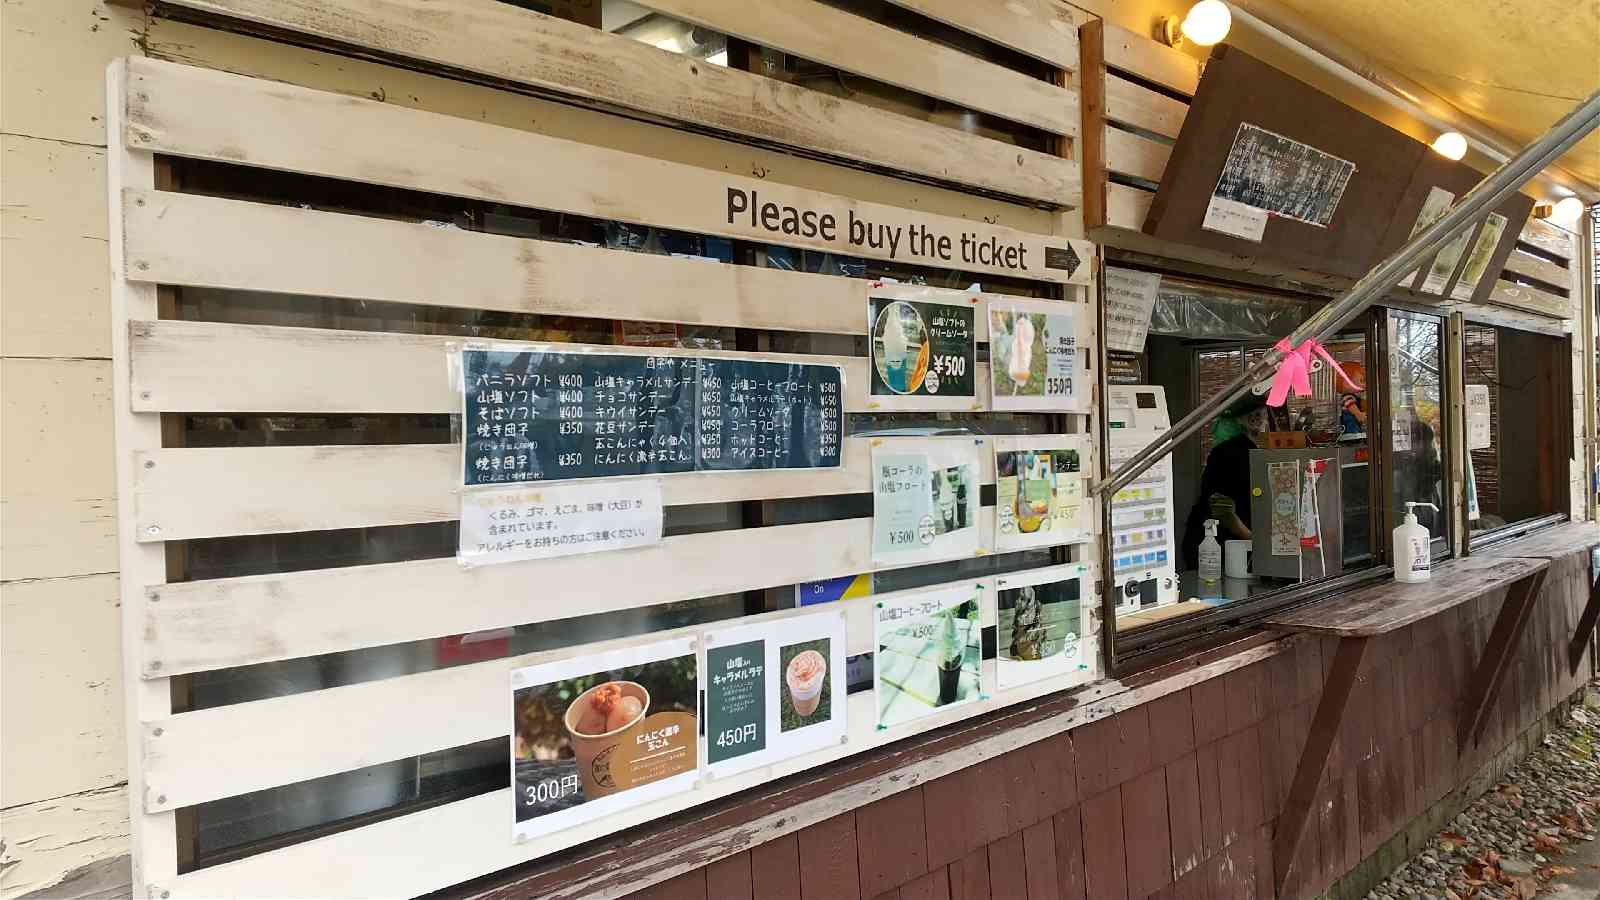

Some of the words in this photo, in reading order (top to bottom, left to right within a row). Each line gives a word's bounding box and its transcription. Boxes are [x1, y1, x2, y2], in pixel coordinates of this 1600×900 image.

[727, 187, 836, 240] Please
[848, 210, 901, 258] buy
[909, 225, 952, 260] the
[961, 232, 1027, 270] ticket
[933, 355, 965, 376] ¥500
[476, 373, 551, 388] バニラソフト
[559, 374, 582, 388] ¥400
[1047, 377, 1072, 395] 350円
[477, 389, 541, 404] 山塩ソフト
[559, 390, 583, 403] ¥400
[595, 391, 667, 403] チョコサンデー
[559, 406, 583, 418] ¥400
[595, 406, 666, 417] キウイサンデー
[477, 422, 528, 437] 焼き団子
[559, 421, 583, 435] ¥350
[595, 421, 656, 434] 花豆サンデー
[475, 455, 527, 471] 焼き団子
[558, 453, 582, 466] ¥350
[889, 528, 914, 544] ¥500
[713, 666, 763, 685] キャラメルラテ
[716, 723, 756, 748] 450円
[526, 774, 578, 806] 300円
